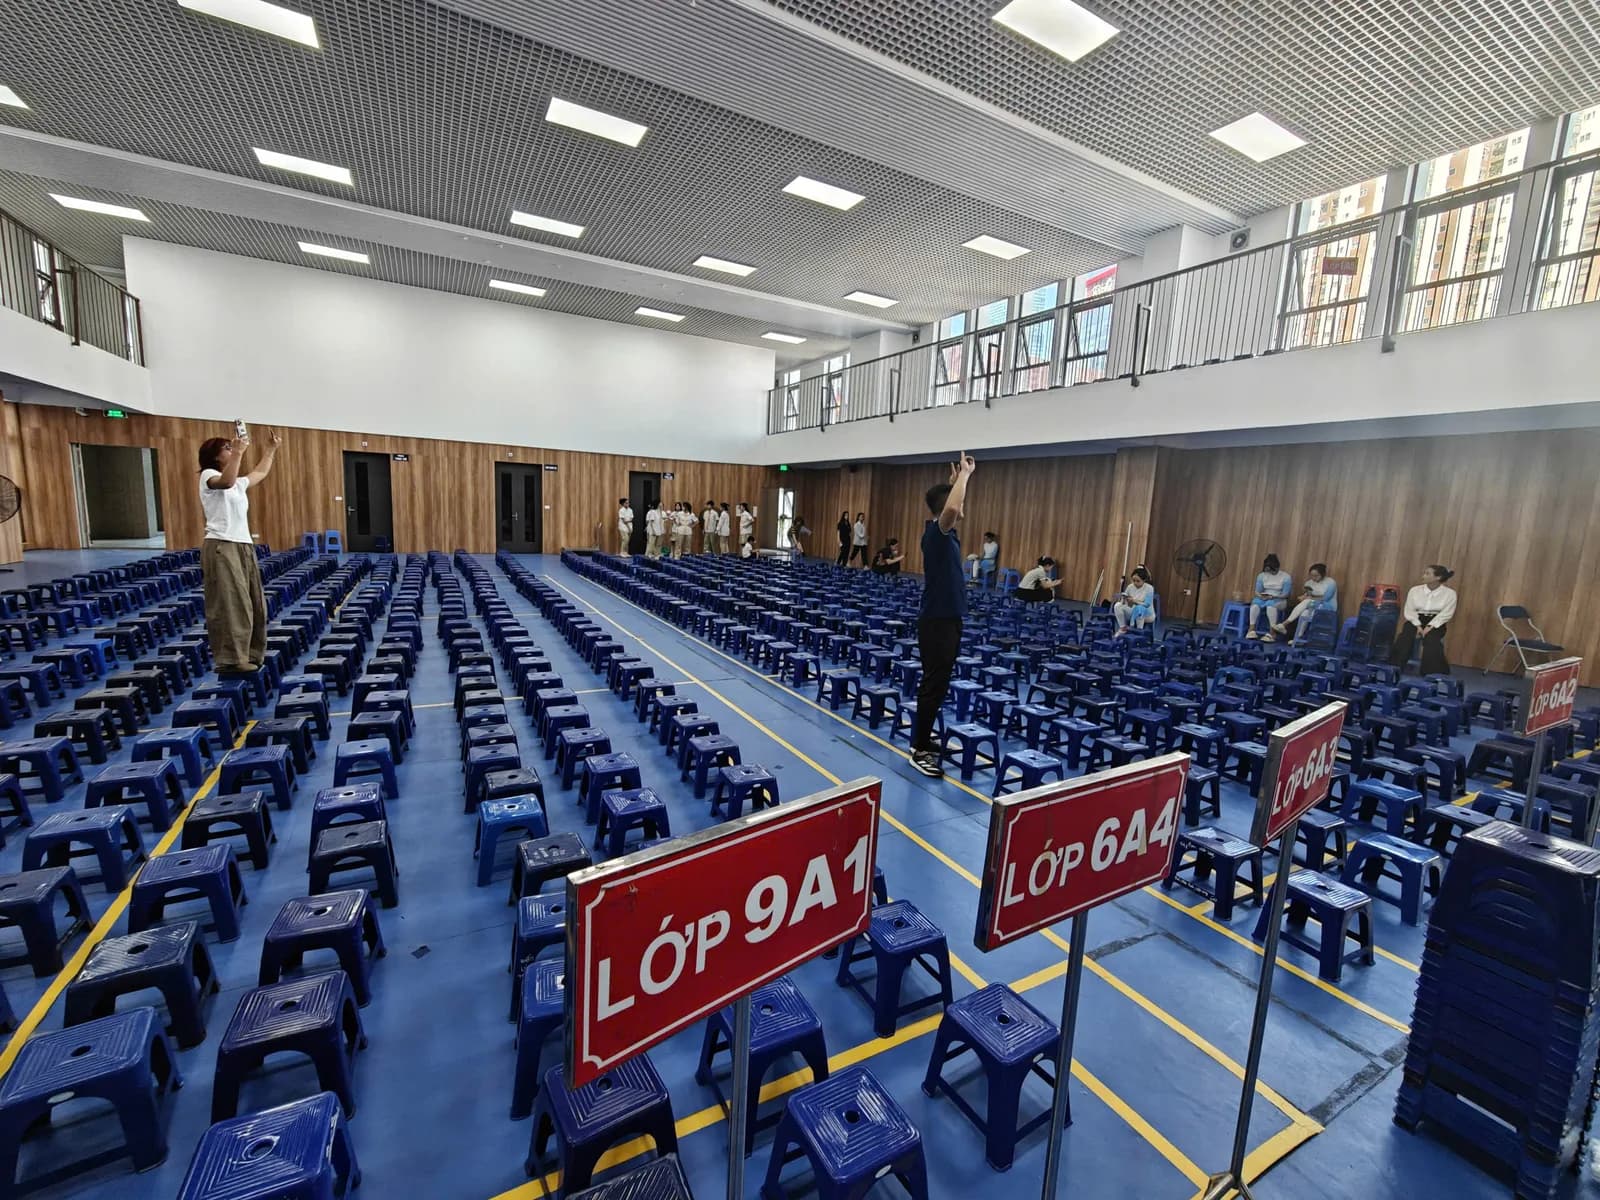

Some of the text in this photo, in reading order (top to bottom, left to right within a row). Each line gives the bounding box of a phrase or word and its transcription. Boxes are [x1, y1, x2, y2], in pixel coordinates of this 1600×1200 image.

[1549, 678, 1577, 710] 6A2
[1303, 736, 1338, 790] 6A3
[1003, 797, 1176, 907] LỚP 6A4
[597, 834, 870, 1022] LỚP 9A1
